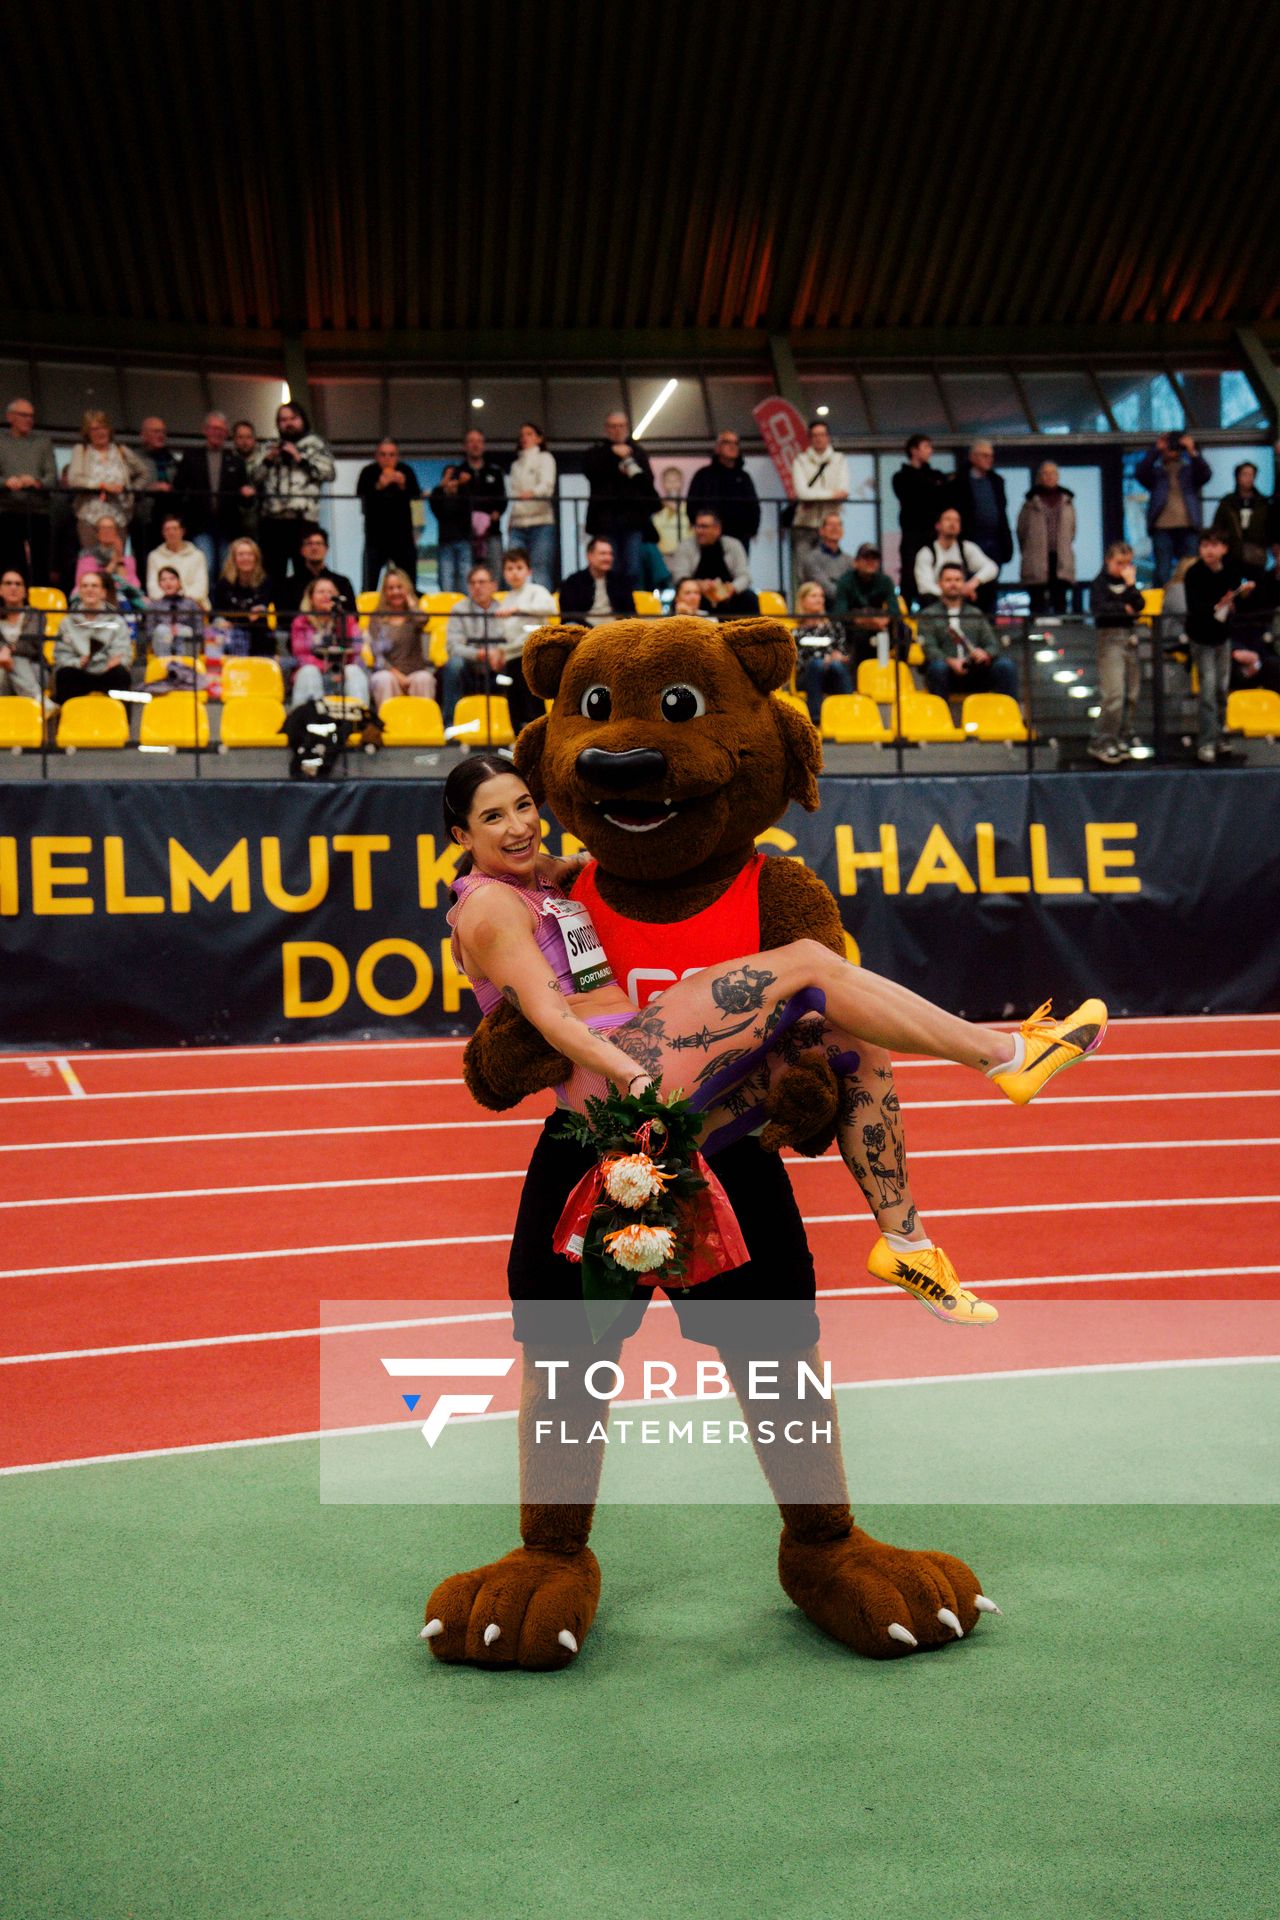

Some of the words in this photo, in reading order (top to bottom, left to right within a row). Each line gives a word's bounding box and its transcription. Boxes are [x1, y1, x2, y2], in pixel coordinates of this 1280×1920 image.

[0, 834, 391, 915] ELMUT
[835, 822, 1142, 896] HALLE
[891, 1258, 958, 1311] NITRO
